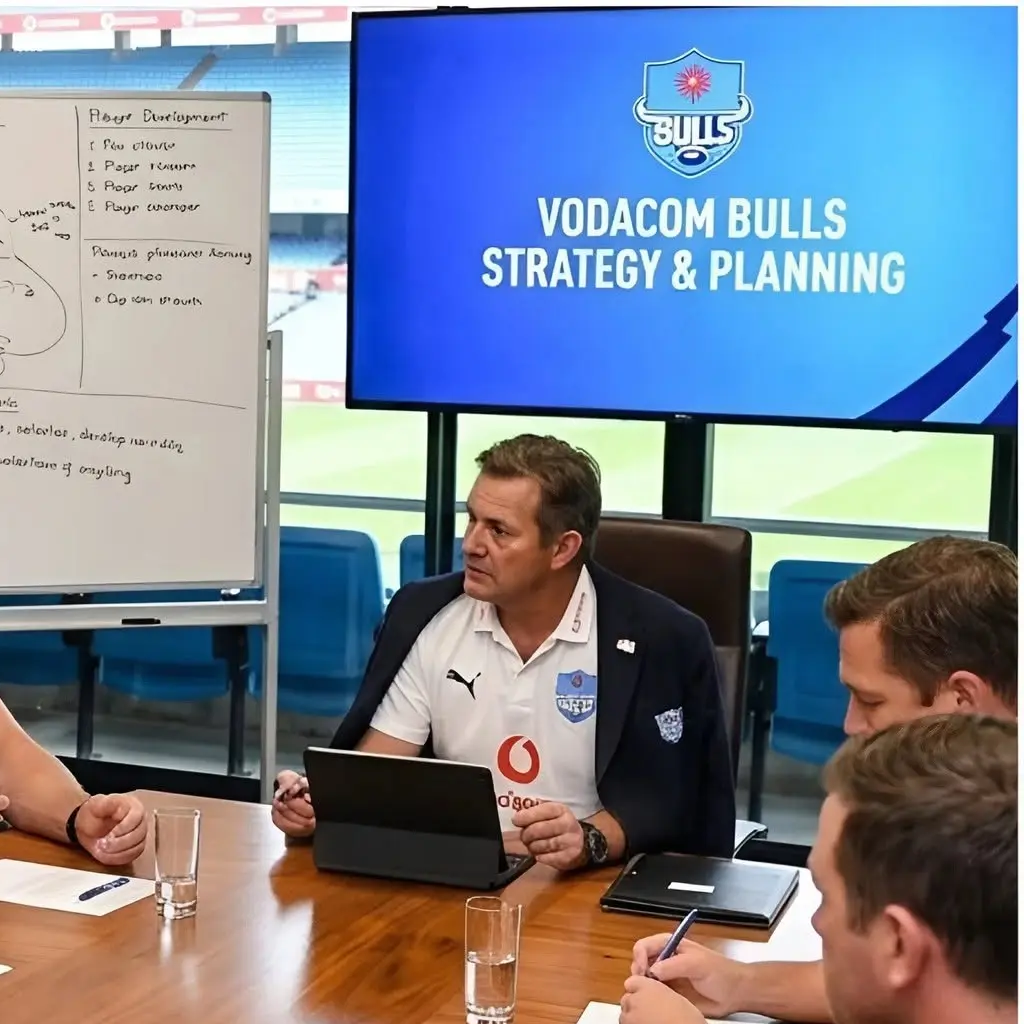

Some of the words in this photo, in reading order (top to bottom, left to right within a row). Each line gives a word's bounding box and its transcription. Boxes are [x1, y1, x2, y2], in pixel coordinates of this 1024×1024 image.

[653, 115, 736, 147] BULLS
[537, 197, 715, 238] VODACOM
[727, 198, 847, 239] BULLS
[482, 247, 662, 289] STRATEGY
[672, 249, 697, 291] &
[709, 249, 906, 294] PLANNING
